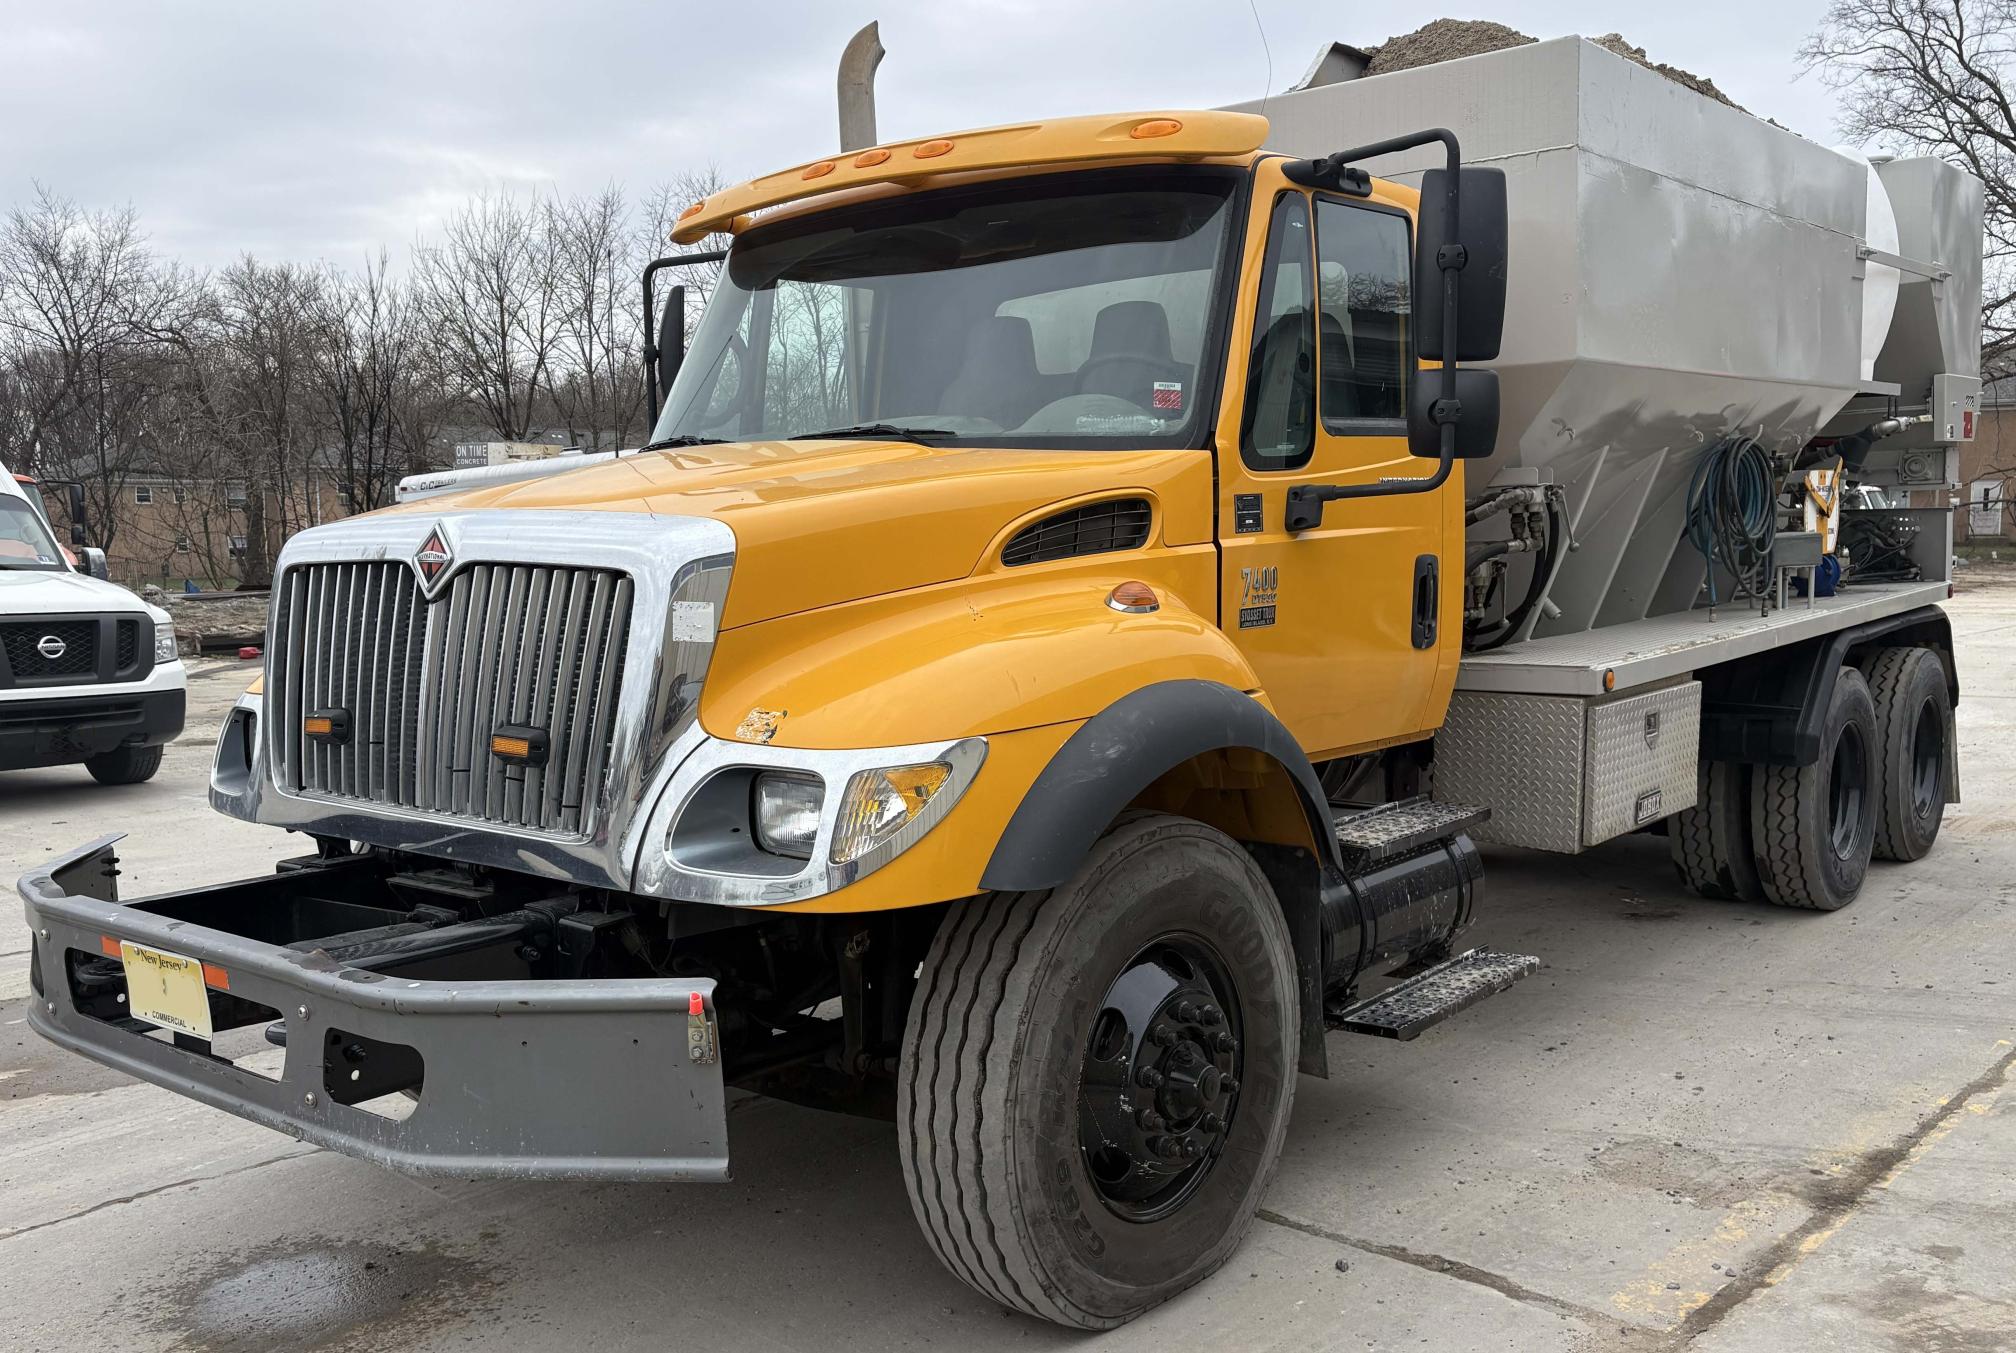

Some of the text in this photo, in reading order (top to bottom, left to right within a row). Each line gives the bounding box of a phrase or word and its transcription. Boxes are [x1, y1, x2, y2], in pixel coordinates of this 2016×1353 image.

[456, 445, 487, 457] ON TIME
[1241, 566, 1278, 606] 7400
[140, 949, 182, 972] New Jersey
[152, 1010, 187, 1028] COMMERCIAL
